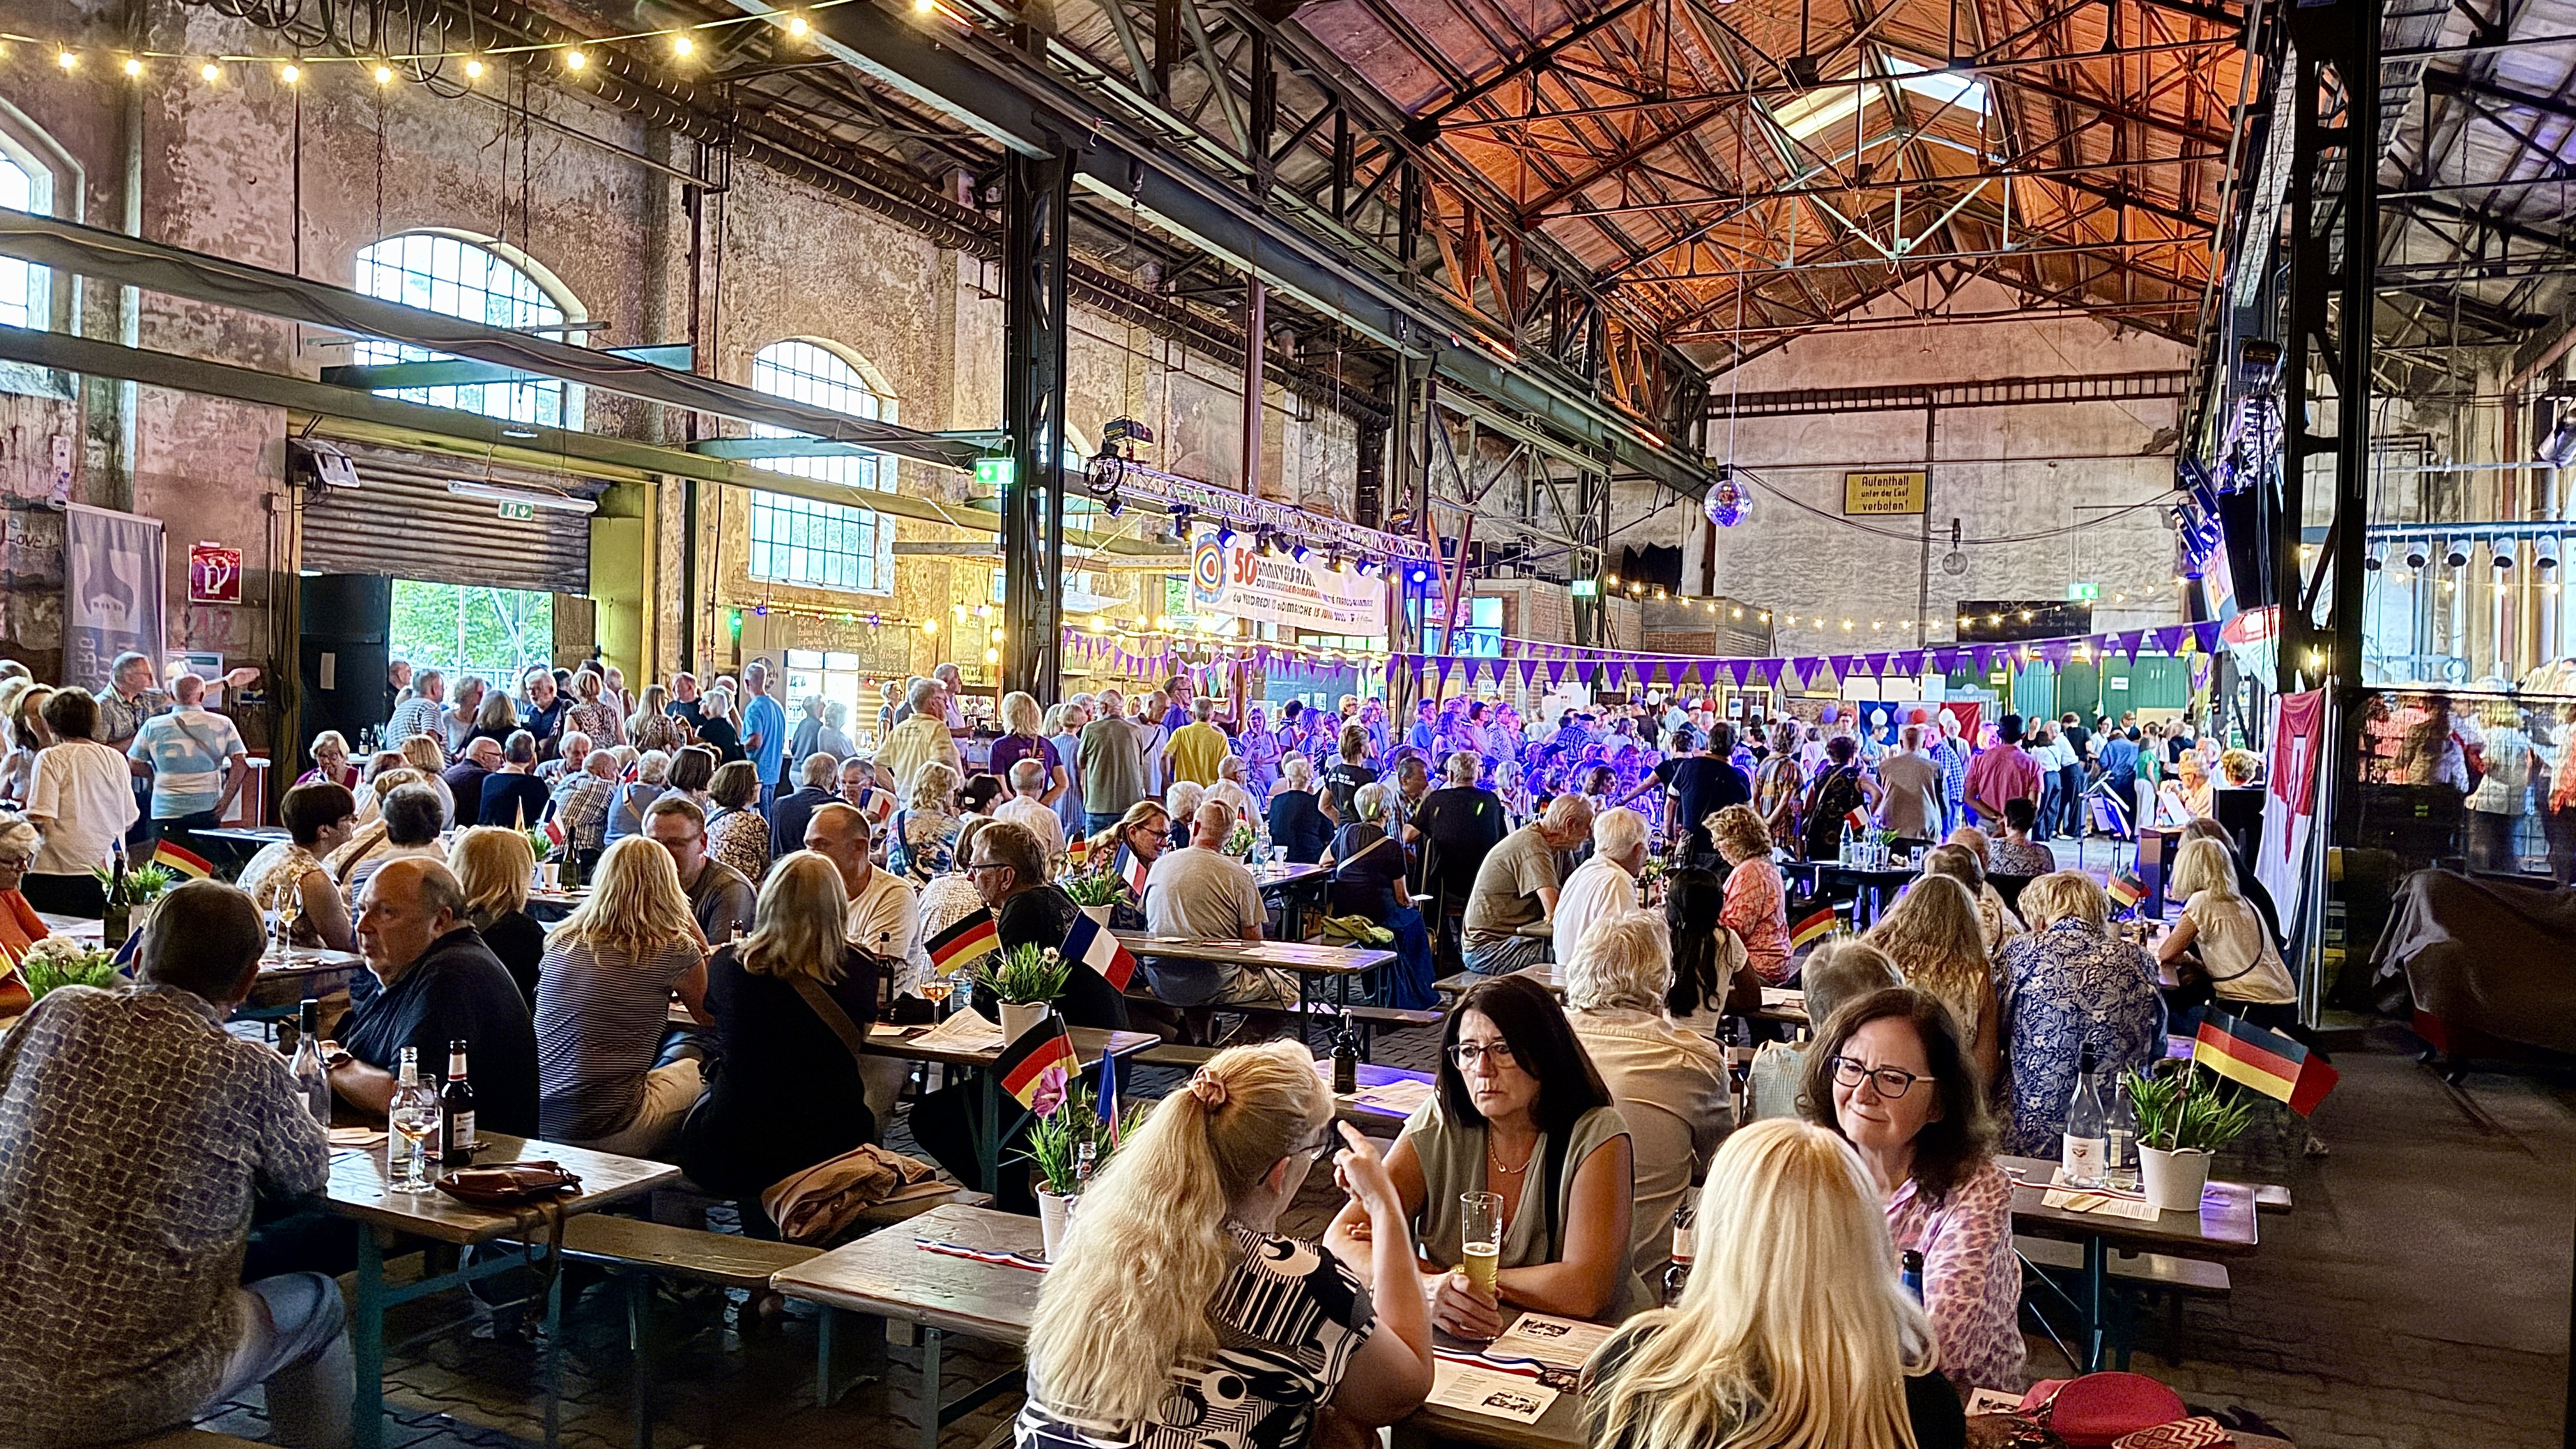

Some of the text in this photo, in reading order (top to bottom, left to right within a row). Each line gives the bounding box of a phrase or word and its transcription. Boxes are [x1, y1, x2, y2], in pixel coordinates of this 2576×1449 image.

[1862, 475, 1909, 487] Aufenthalt
[1894, 487, 1908, 497] Last
[1862, 500, 1908, 510] verboten!
[1234, 548, 1257, 586] 50
